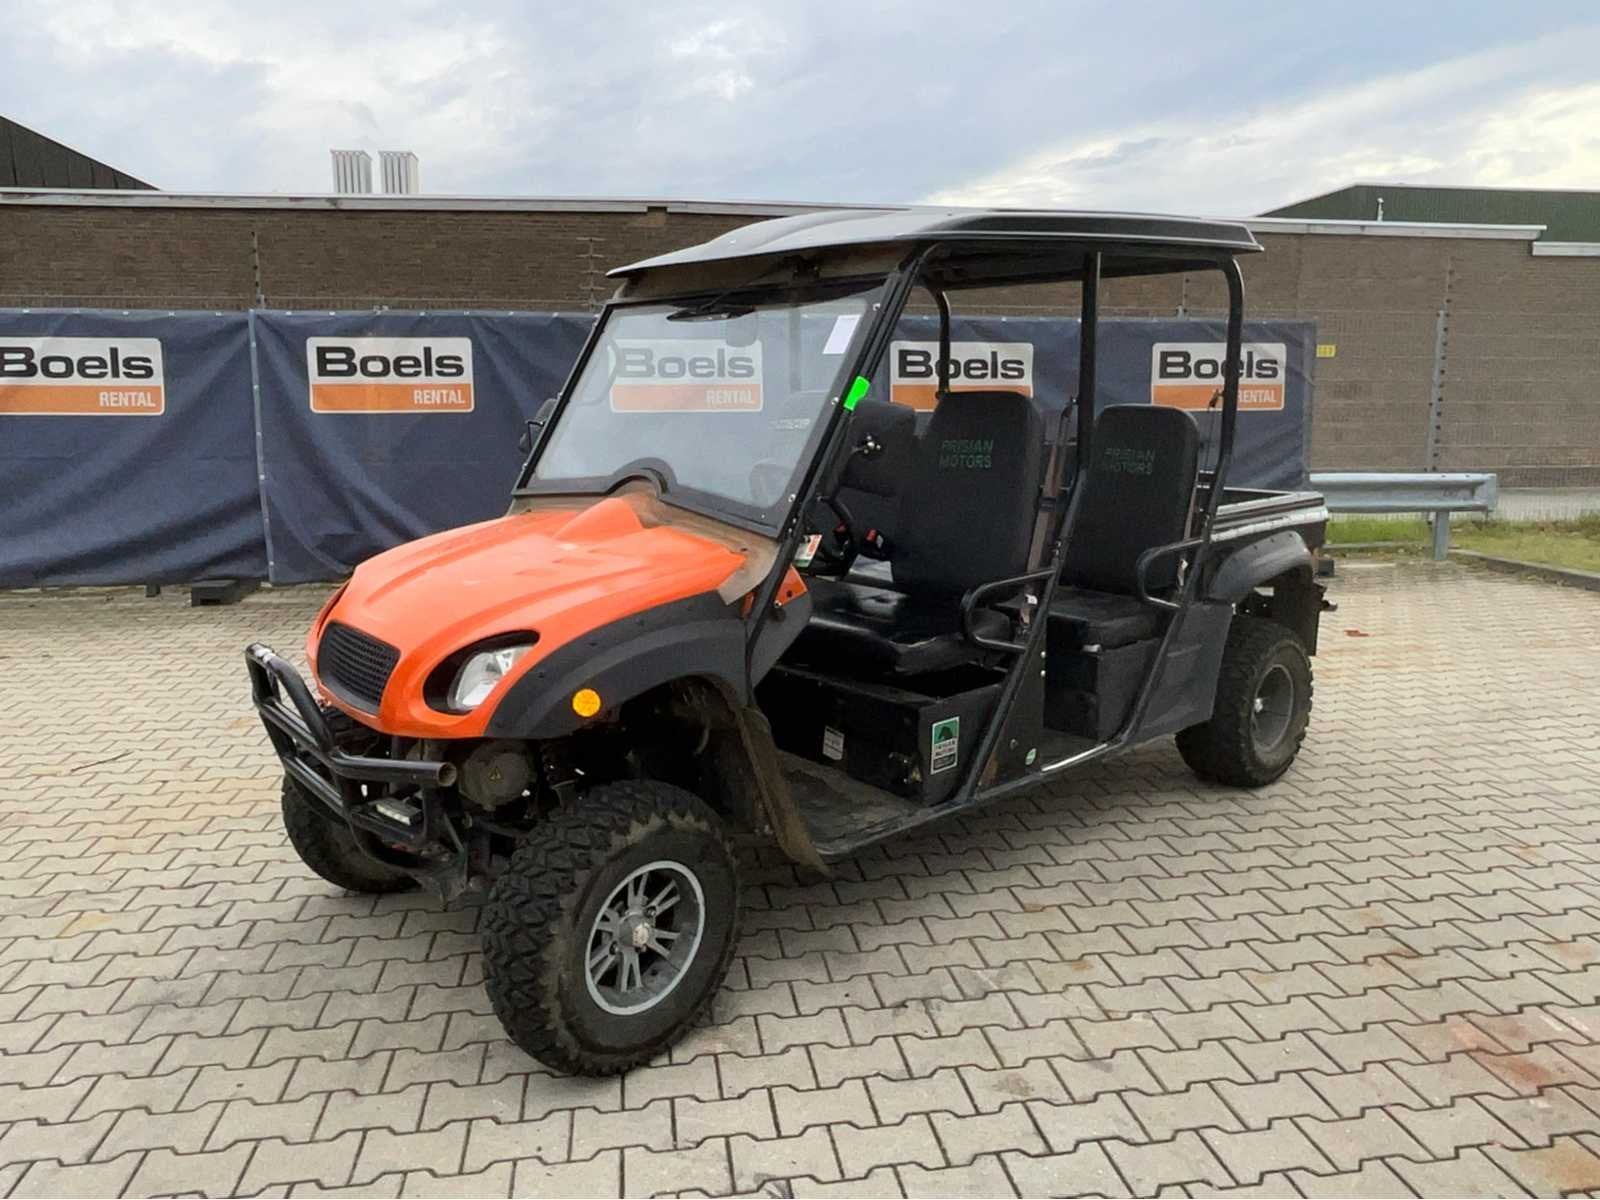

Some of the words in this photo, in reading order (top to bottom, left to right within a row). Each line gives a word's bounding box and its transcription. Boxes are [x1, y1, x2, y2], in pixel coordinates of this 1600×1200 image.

[0, 346, 154, 379] Boels
[316, 346, 465, 378] Boels
[616, 348, 755, 378] Boels
[898, 350, 1025, 379] Boels
[99, 391, 156, 408] RENTAL
[413, 389, 465, 405] RENTAL
[706, 389, 753, 405] RENTAL
[939, 454, 993, 469] MOTORS
